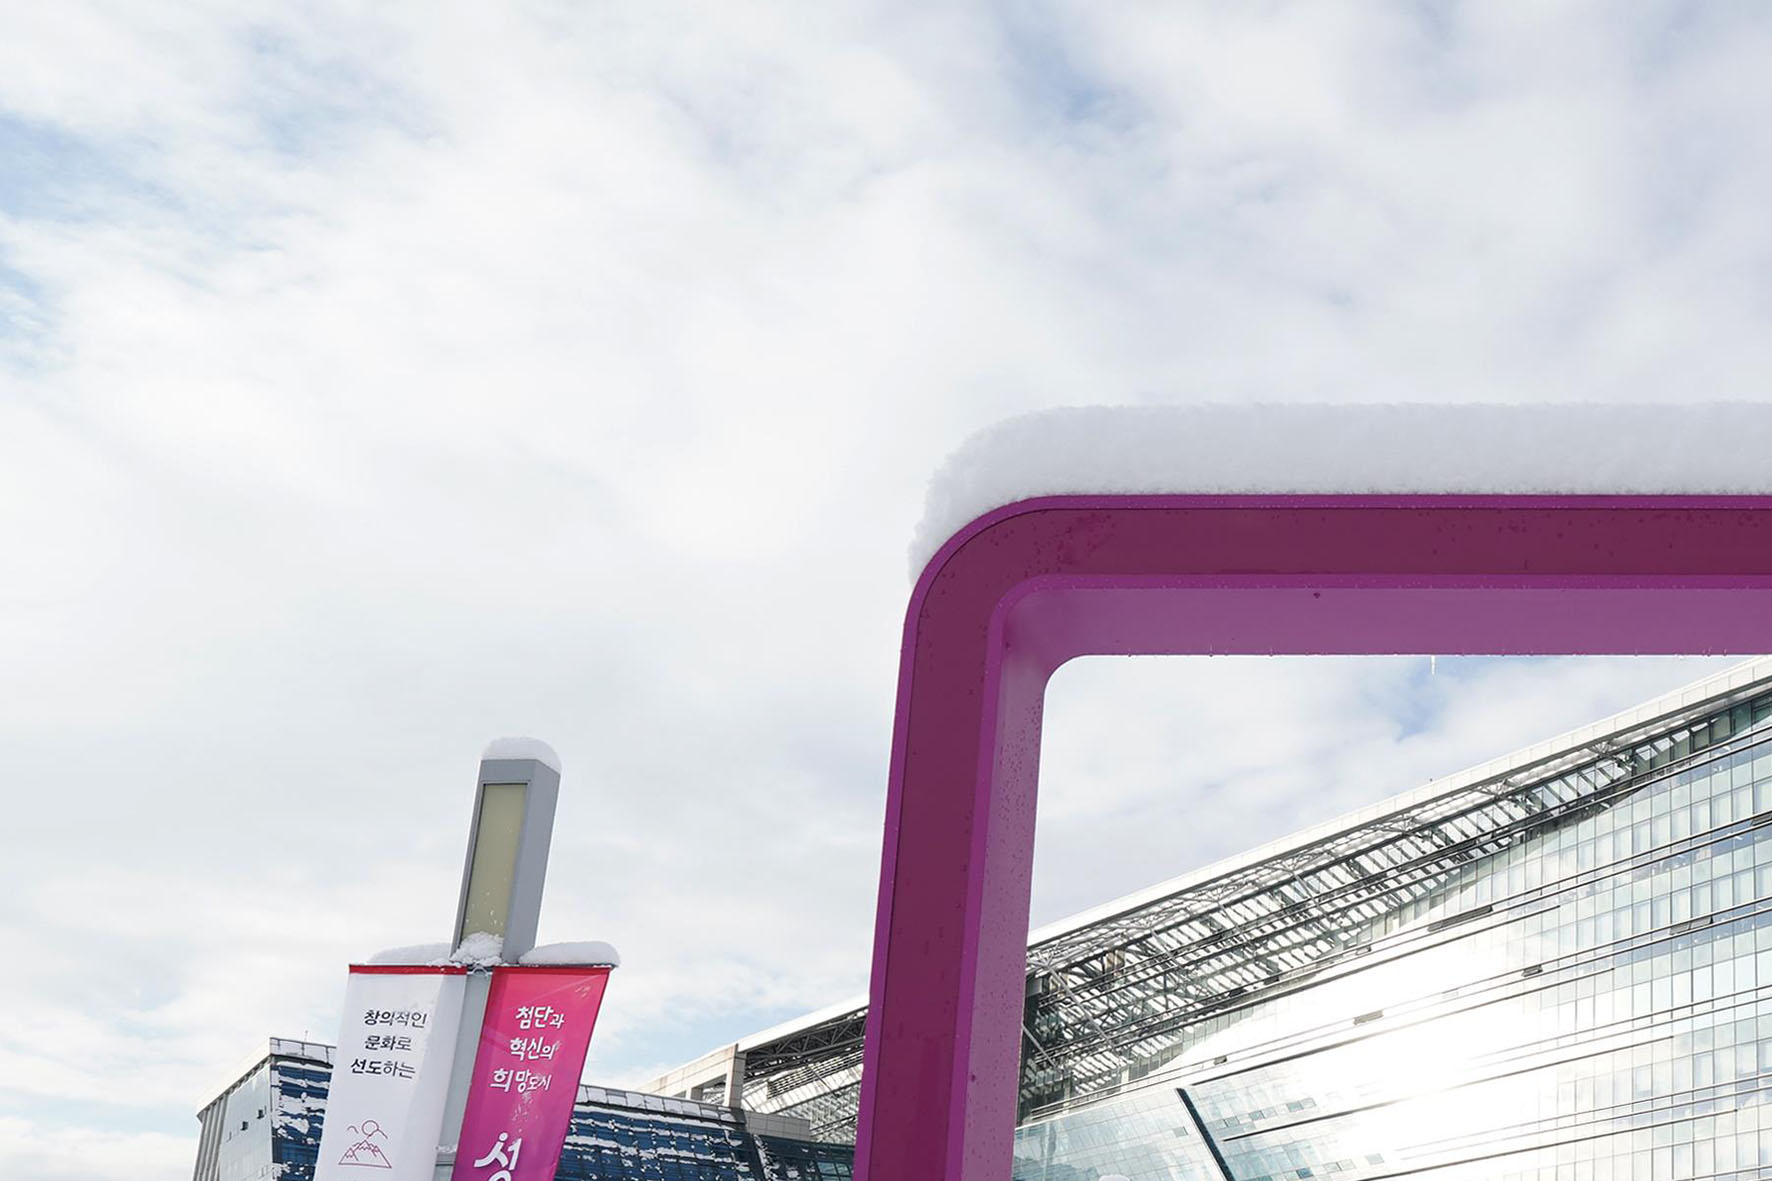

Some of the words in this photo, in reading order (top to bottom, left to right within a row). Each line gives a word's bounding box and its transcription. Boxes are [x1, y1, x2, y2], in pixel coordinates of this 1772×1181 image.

[364, 1009, 428, 1029] 창의적인
[516, 1006, 565, 1029] 첨단과
[365, 1035, 412, 1051] 문화로
[510, 1036, 556, 1061] 혁신의
[351, 1058, 416, 1079] 선도하는
[490, 1067, 552, 1093] 희망도시
